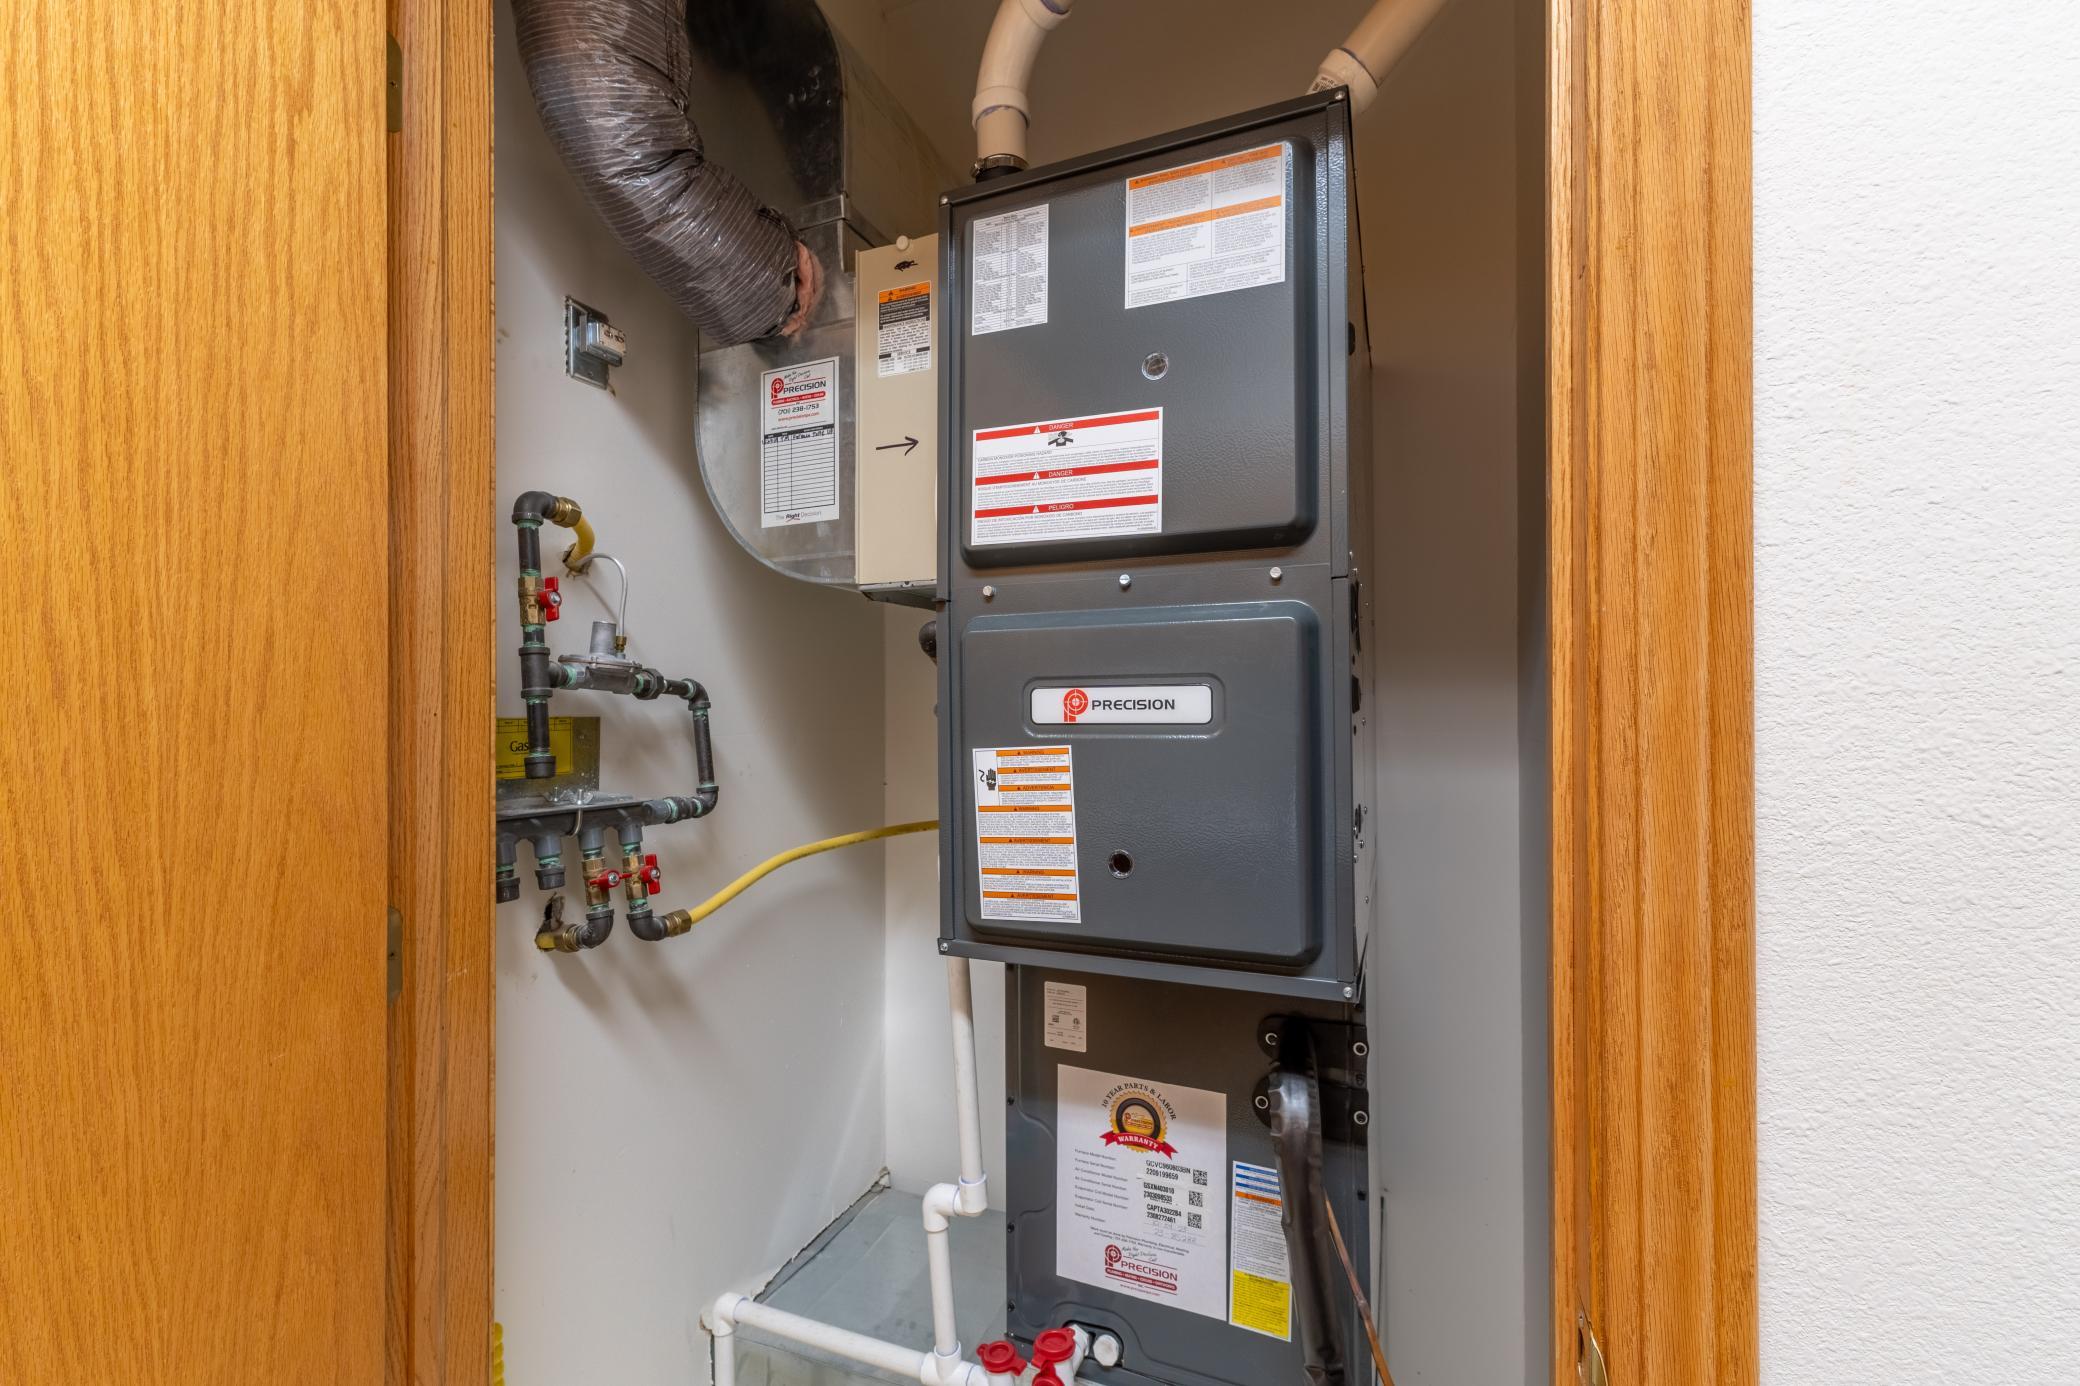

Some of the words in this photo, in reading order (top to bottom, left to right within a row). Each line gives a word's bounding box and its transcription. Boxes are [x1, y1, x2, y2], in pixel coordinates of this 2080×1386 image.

[783, 380, 826, 394] PRECISION
[792, 403, 820, 413] 238-1753
[1048, 422, 1074, 431] DANGER
[1048, 469, 1073, 478] DANGER
[1048, 503, 1074, 511] PELIGRO
[1091, 699, 1176, 711] PRECISION
[509, 740, 529, 752] Gas
[1101, 1098, 1109, 1108] 10
[1106, 1085, 1124, 1099] YEAR
[1124, 1082, 1149, 1091] PARTS
[1150, 1088, 1156, 1096] &
[1157, 1093, 1177, 1120] LABOR
[1118, 1135, 1159, 1149] WARRANTY
[1120, 1260, 1178, 1281] PRECISION
